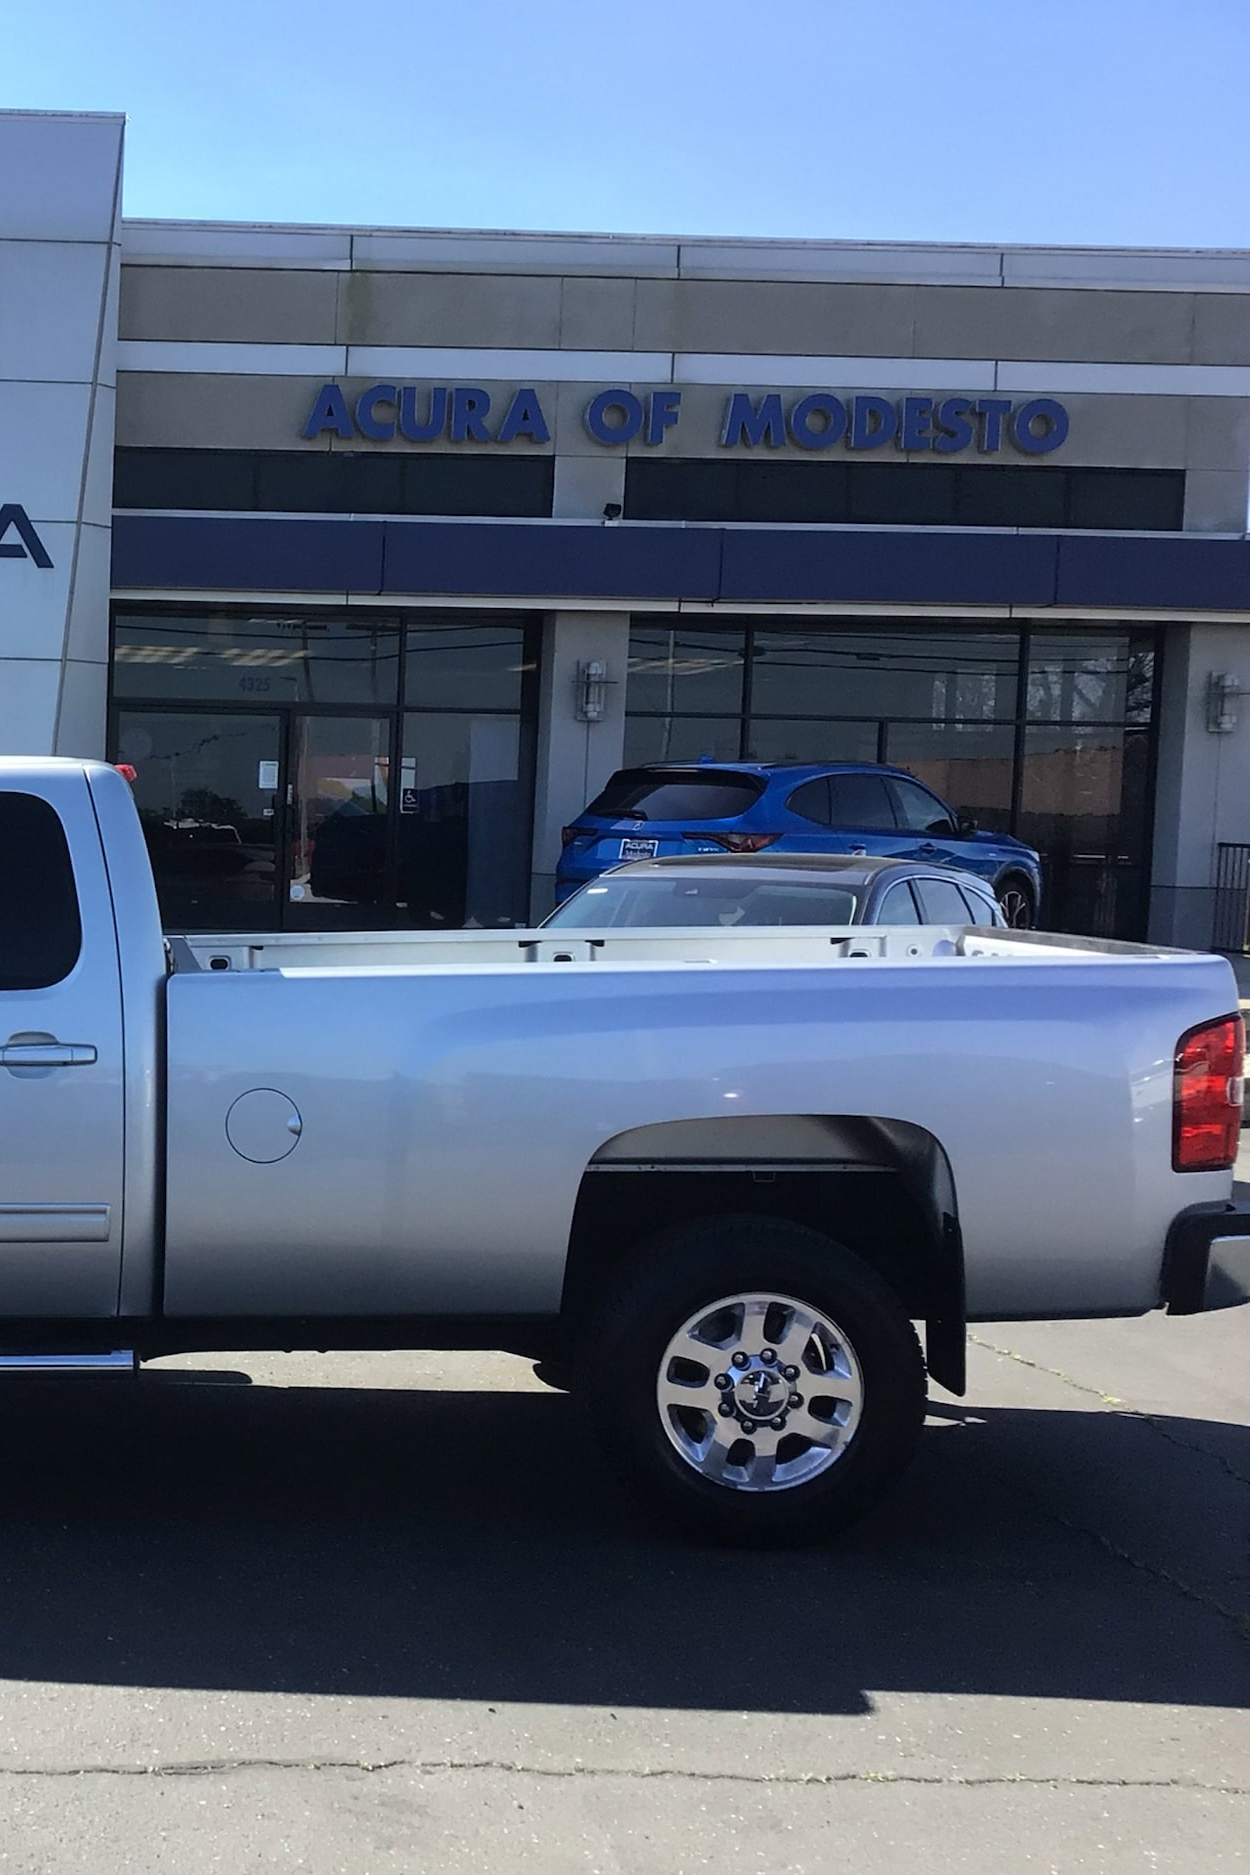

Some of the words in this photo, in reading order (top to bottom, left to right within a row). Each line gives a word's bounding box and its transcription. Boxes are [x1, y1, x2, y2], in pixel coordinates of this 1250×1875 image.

[302, 384, 551, 442] ACURA
[584, 389, 682, 446] OF
[721, 393, 1070, 454] MODESTO
[238, 676, 271, 692] 4325
[624, 842, 654, 850] ACURA
